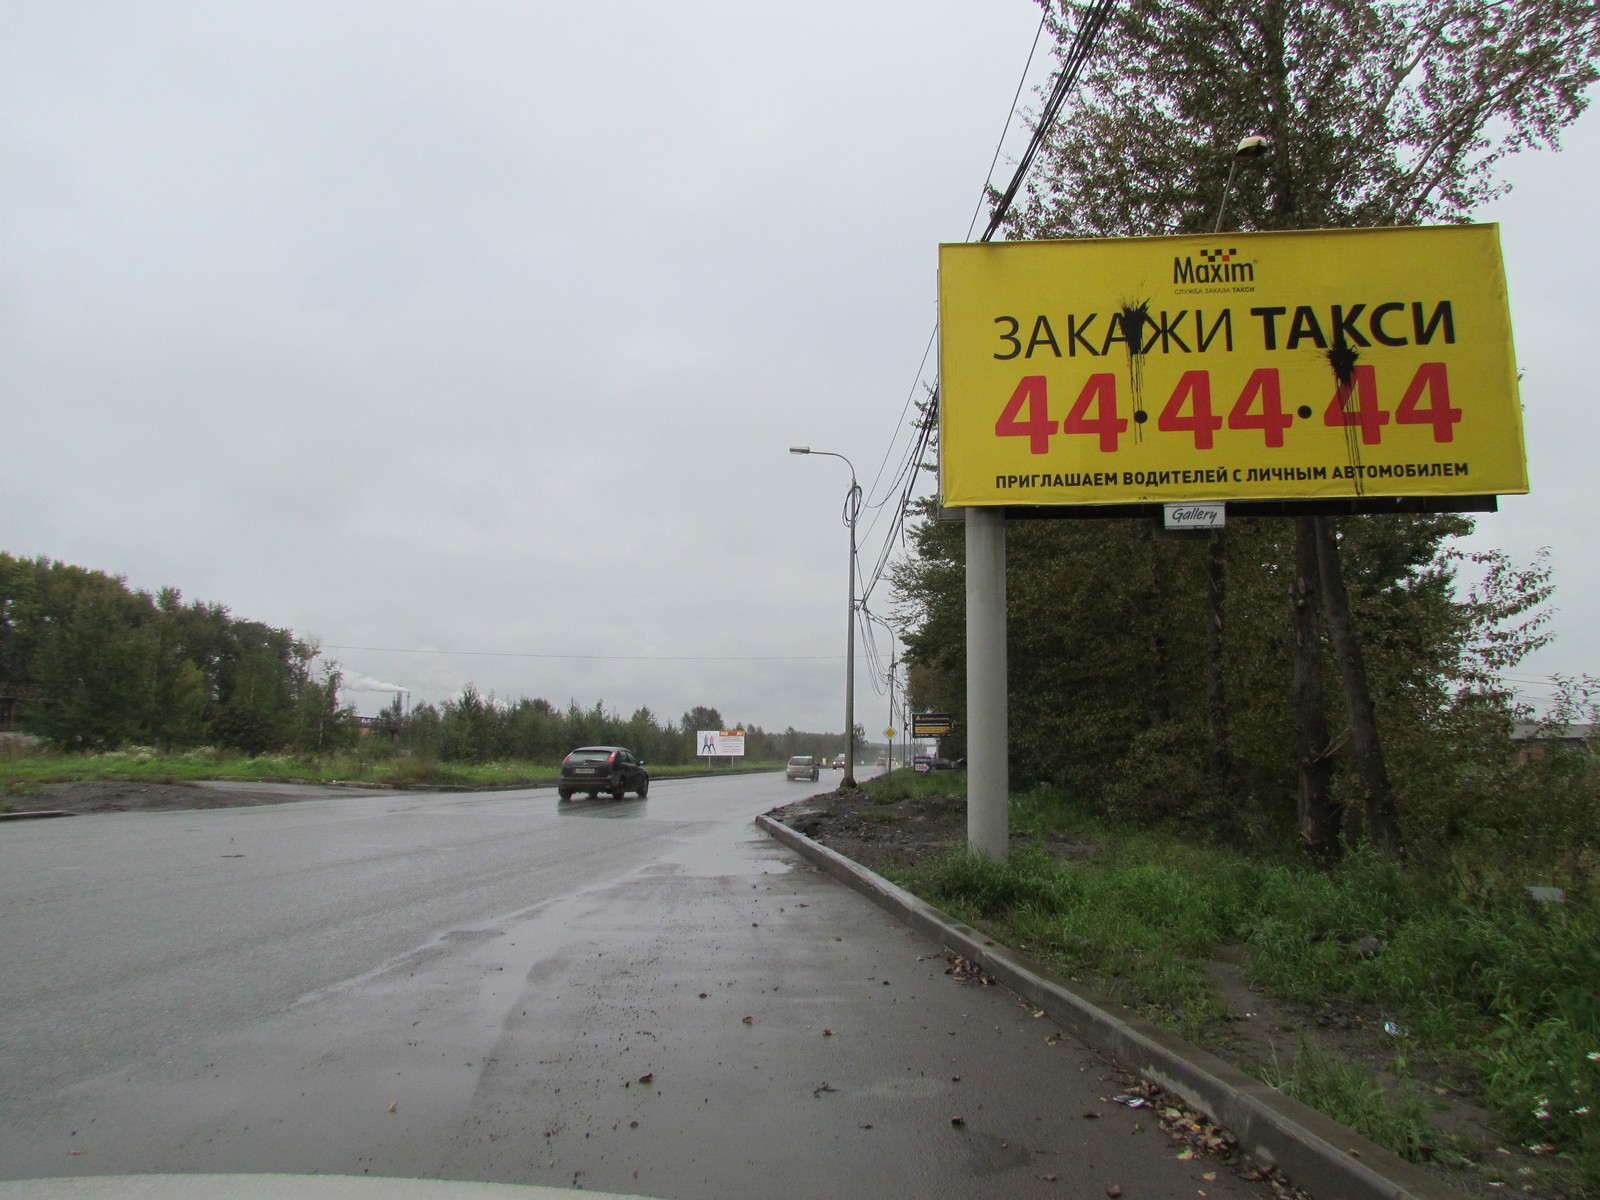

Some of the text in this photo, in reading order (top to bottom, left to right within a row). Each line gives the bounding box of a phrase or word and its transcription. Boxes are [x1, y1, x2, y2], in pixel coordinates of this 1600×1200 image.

[1173, 256, 1254, 284] Maxim
[993, 300, 1456, 361] ЗАКАЖИ ТАКСИ
[995, 463, 1468, 489] ПРИГЛАШАЕМ ВОДИТЕЛЕЙ С ЛИЧНЫМ АВТОМОБИЛЕМ
[1172, 507, 1218, 525] Gallery
